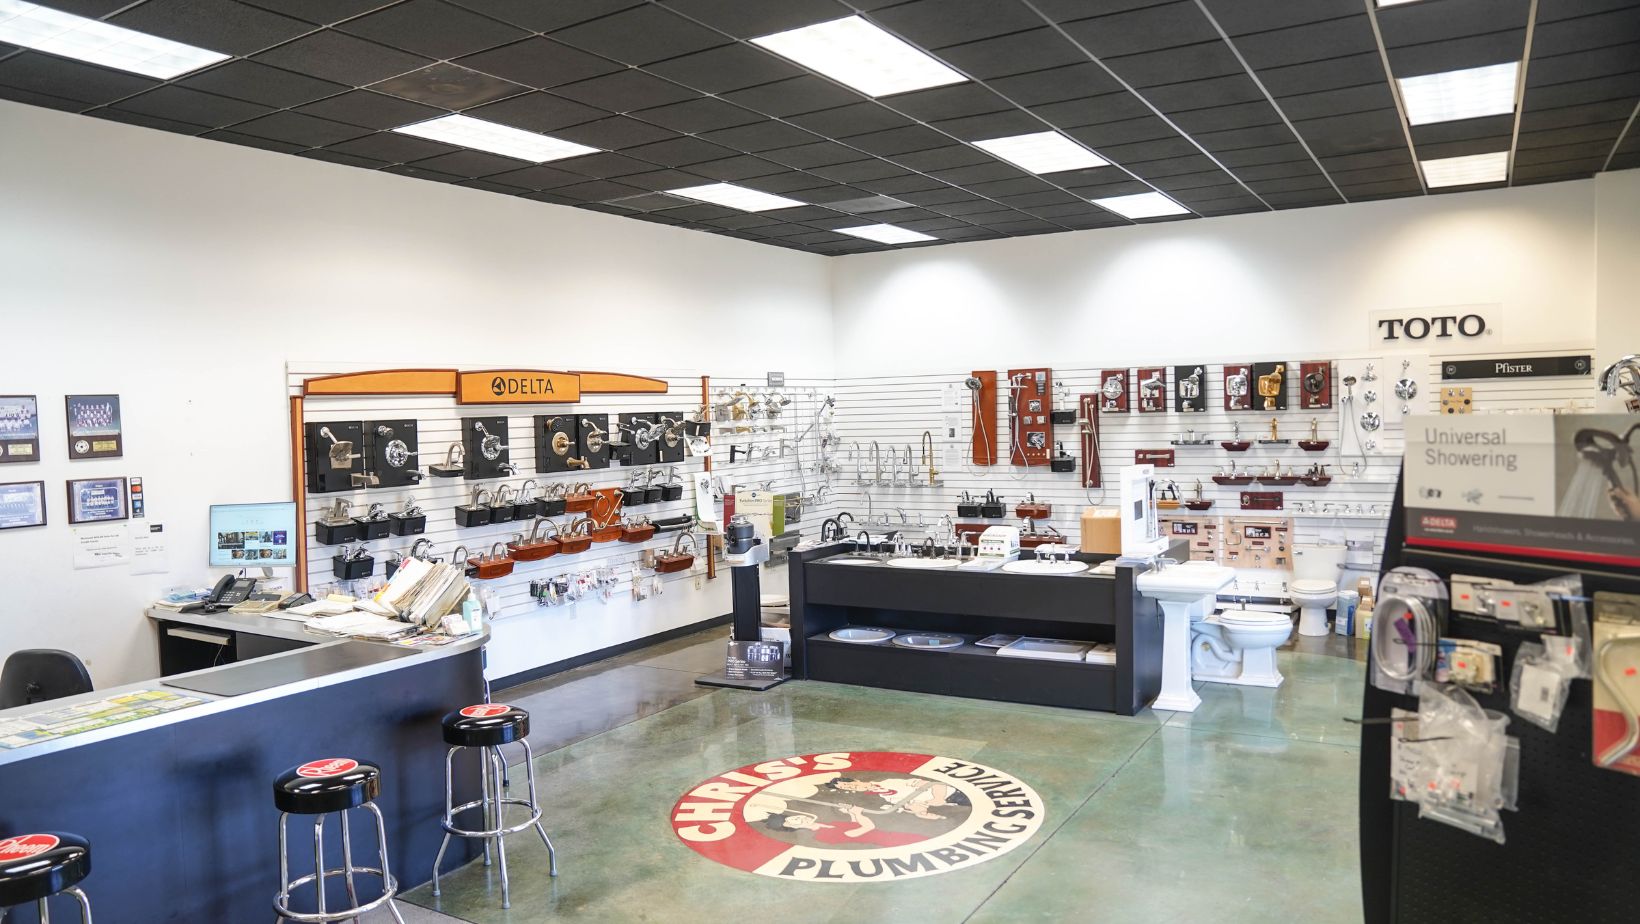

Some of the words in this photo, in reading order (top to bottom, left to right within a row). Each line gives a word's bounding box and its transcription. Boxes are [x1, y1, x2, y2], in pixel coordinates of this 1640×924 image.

[1378, 314, 1486, 340] TOTO
[508, 377, 555, 395] DELTA
[1425, 427, 1506, 446] Universal
[1425, 449, 1518, 472] Showering
[674, 752, 852, 842] CHRIS'S
[778, 819, 1028, 879] PLUMBING
[935, 761, 1035, 820] SERVICE
